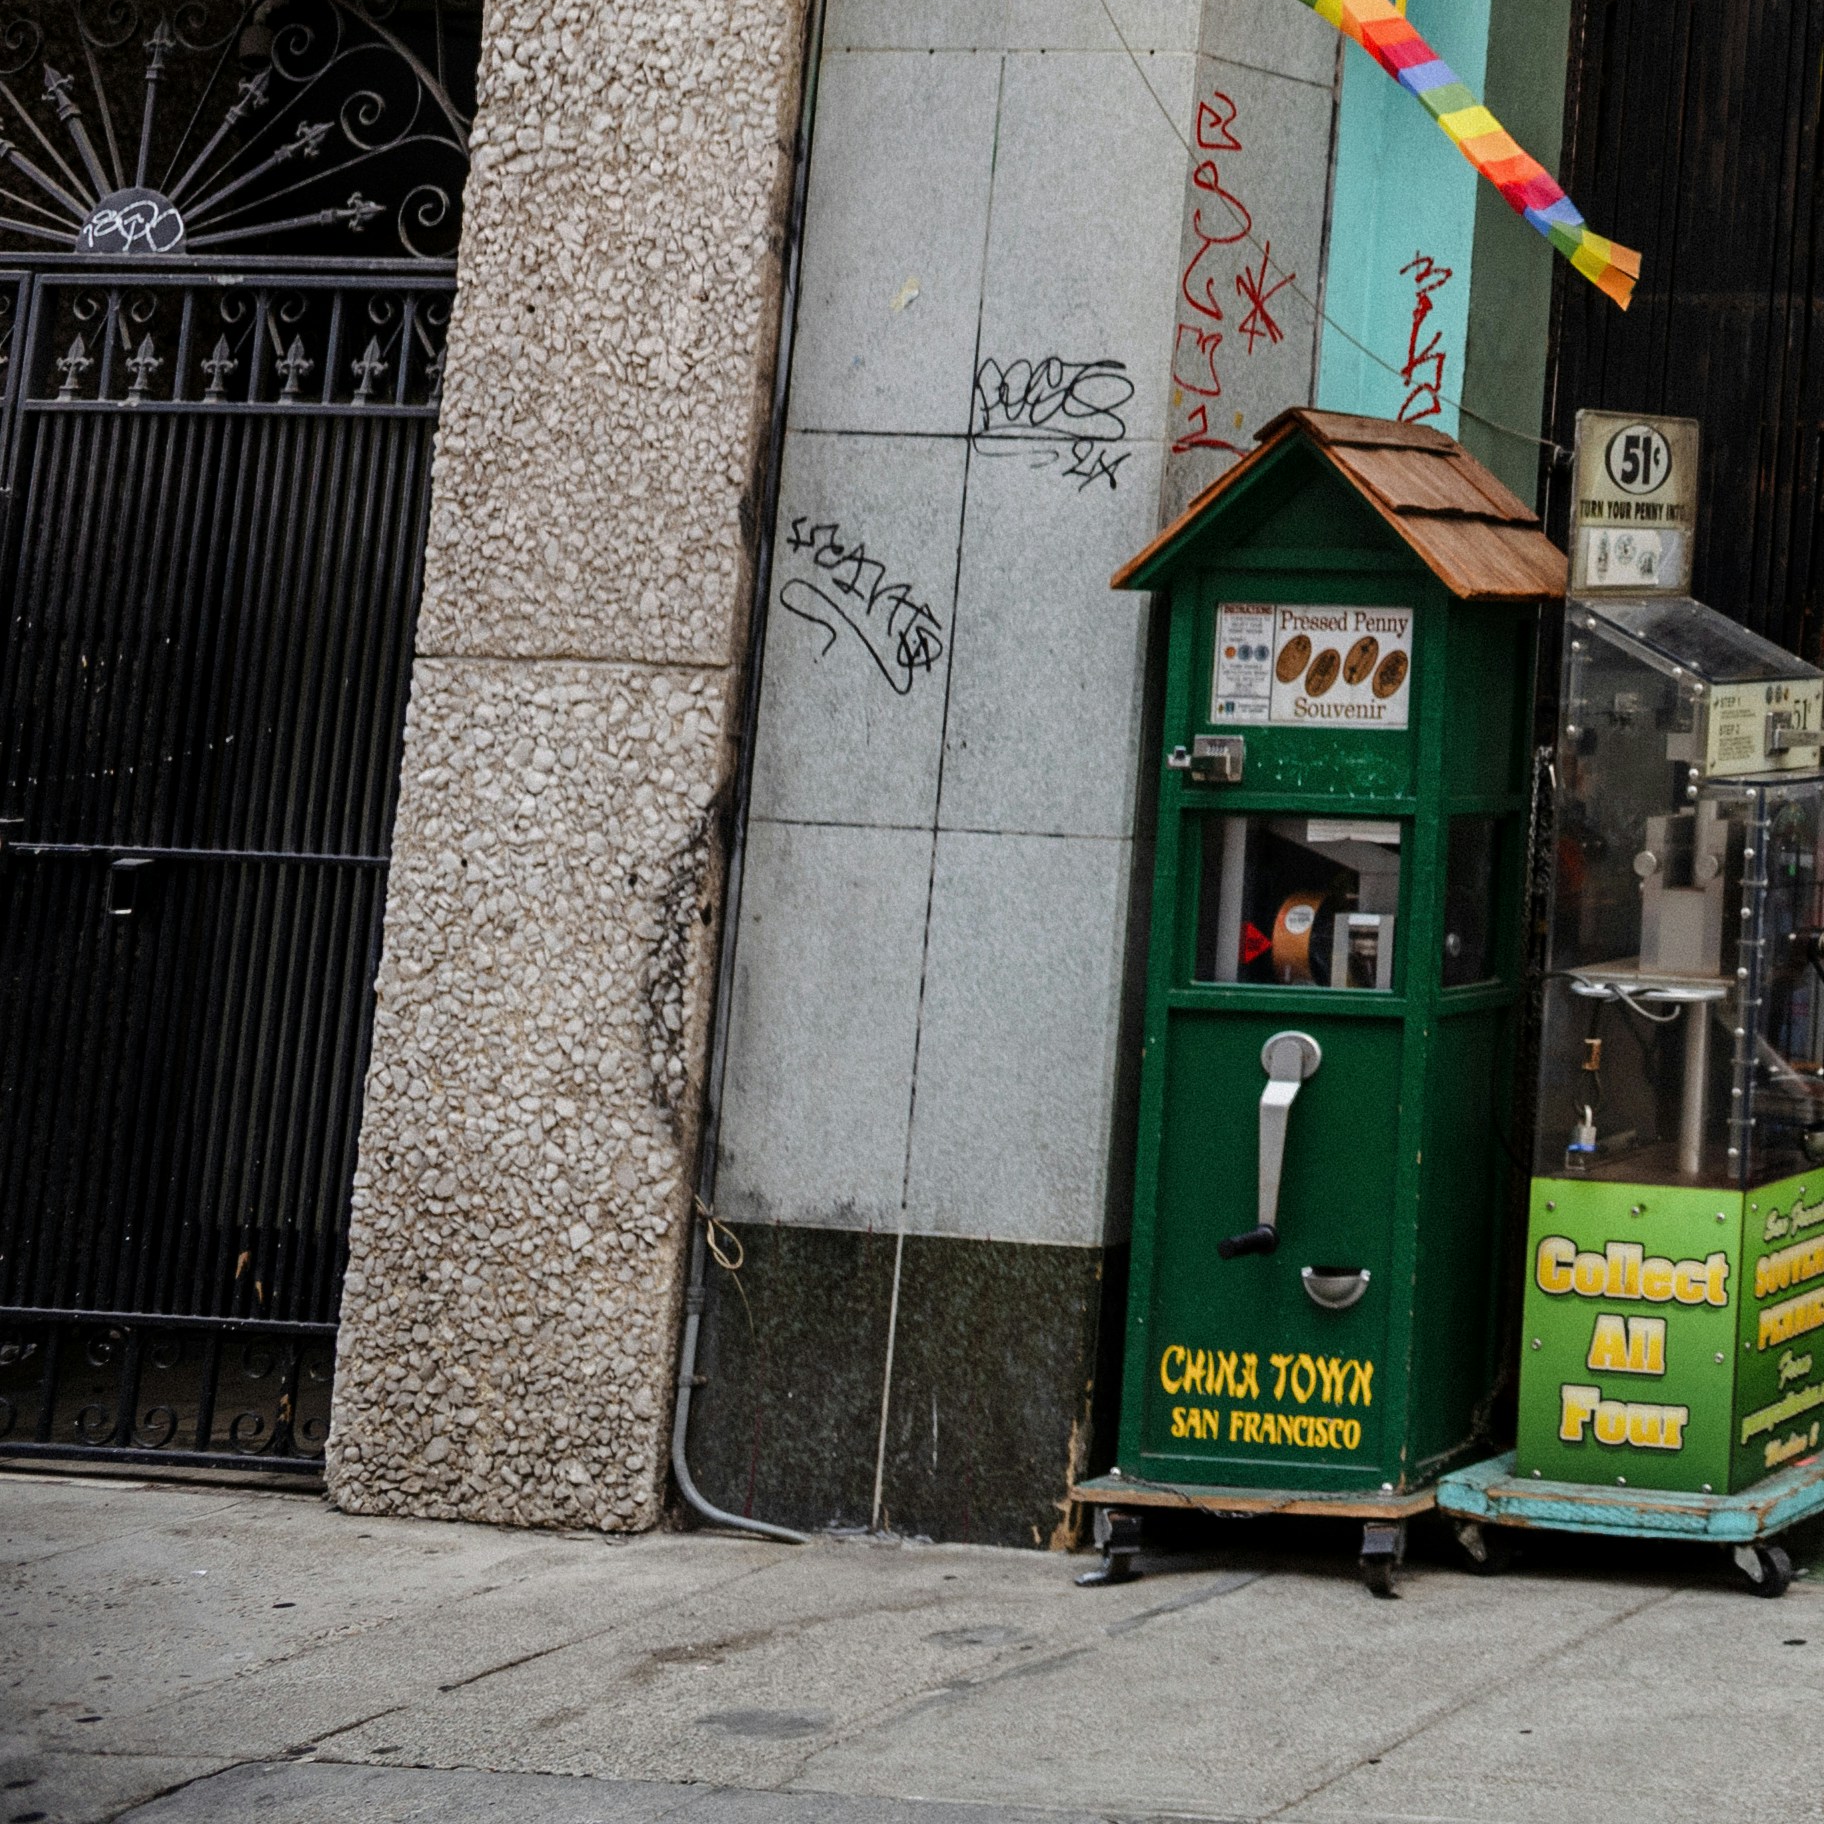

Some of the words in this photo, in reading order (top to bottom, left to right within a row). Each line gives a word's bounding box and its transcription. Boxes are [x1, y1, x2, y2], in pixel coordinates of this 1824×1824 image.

[1579, 498, 1604, 519] TURN
[1607, 500, 1632, 520] YOUR
[1635, 502, 1665, 522] PENNY
[1281, 609, 1348, 632] Pressed
[1354, 611, 1409, 639] Penny
[1293, 695, 1387, 720] Souvenir
[1537, 1235, 1730, 1307] Collect
[1587, 1313, 1667, 1375] All
[1160, 1344, 1261, 1401] CHINA
[1269, 1352, 1375, 1407] TOWN
[1170, 1405, 1220, 1440] SAN
[1229, 1409, 1362, 1450] FRANCISCO
[1559, 1384, 1689, 1450] Four
